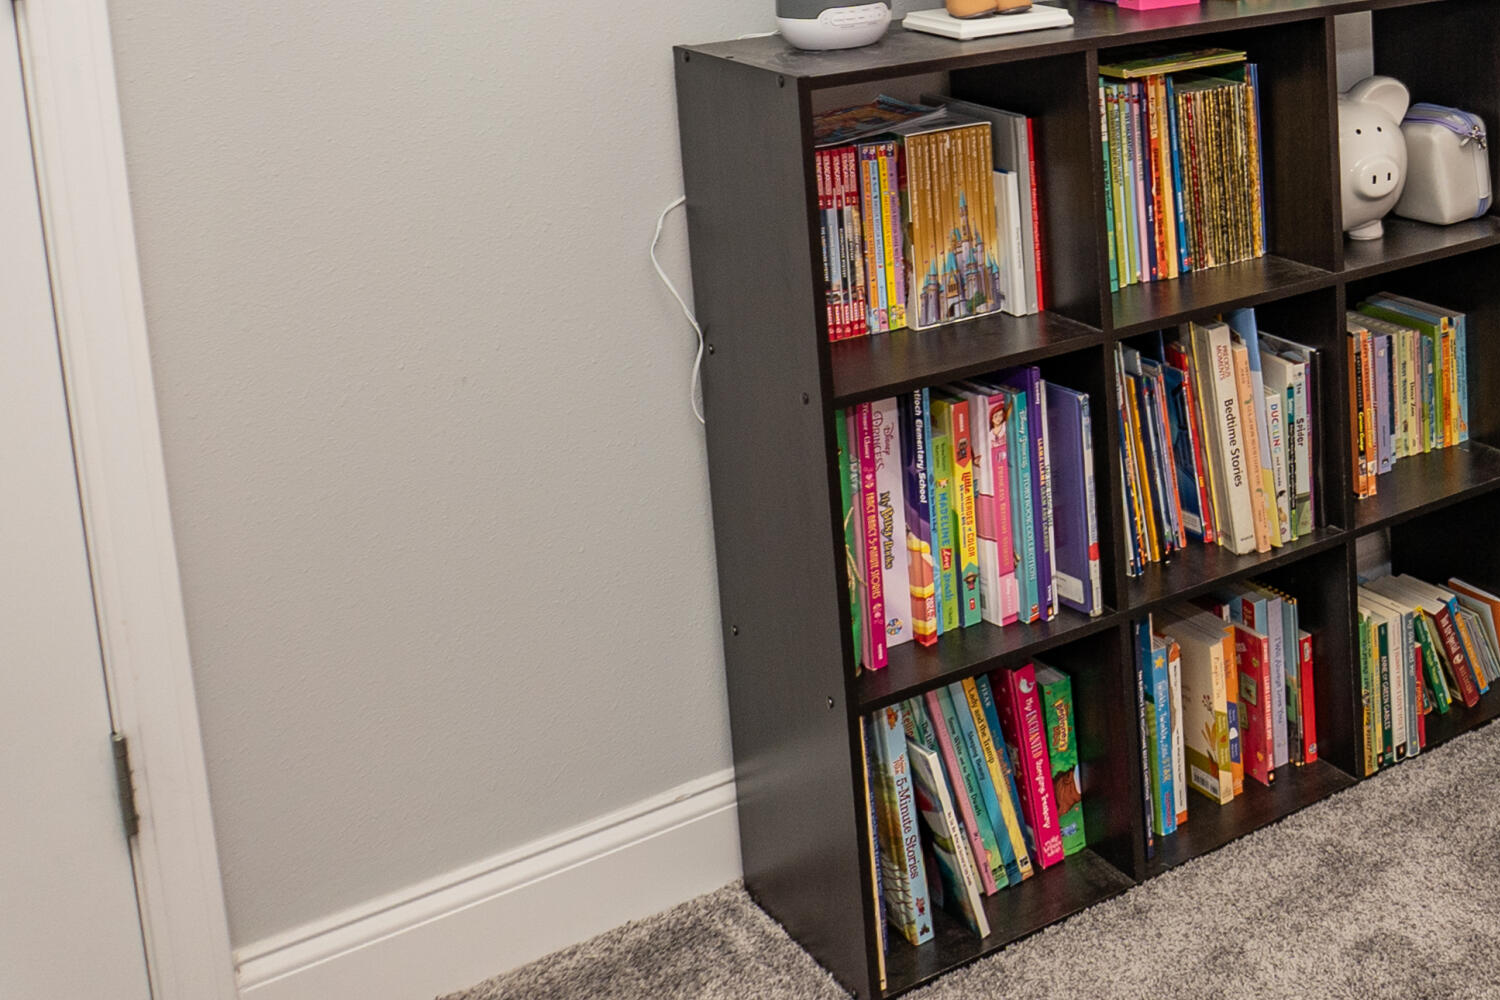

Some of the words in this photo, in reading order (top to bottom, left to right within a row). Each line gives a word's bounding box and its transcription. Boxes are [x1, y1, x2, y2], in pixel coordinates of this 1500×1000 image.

[1216, 345, 1225, 381] MOMENTS
[1221, 345, 1231, 378] PRECIOUS
[1018, 410, 1027, 434] Disney
[1270, 404, 1281, 454] DUCKLING
[1296, 418, 1305, 448] Spider
[872, 411, 886, 472] PRINCESS
[883, 422, 895, 455] Disney
[913, 419, 925, 469] Elementary
[1019, 437, 1029, 468] Princess
[1223, 398, 1237, 446] Bedtime
[1230, 449, 1244, 487] Stories
[880, 491, 890, 507] My
[918, 472, 928, 504] School
[963, 472, 972, 494] Little
[997, 466, 1006, 501] PRINCESS
[1022, 472, 1032, 522] STORYBOOK
[865, 492, 875, 513] FANCY
[963, 495, 974, 526] HEROES
[866, 515, 877, 537] NANCY
[880, 508, 896, 536] Busy
[939, 492, 949, 546] MADELINE
[999, 503, 1008, 535] BEDTIME
[867, 538, 879, 568] 5-MINUTE
[883, 537, 895, 569] Books
[965, 533, 976, 558] COLOR
[1001, 536, 1010, 567] STORIES
[1026, 524, 1036, 580] COLLECTION
[870, 568, 880, 599] STORIES
[1440, 614, 1450, 628] You
[1446, 635, 1460, 654] Special
[1274, 659, 1283, 688] Always
[981, 683, 991, 708] PIXAR
[1023, 697, 1033, 711] My
[967, 688, 979, 708] Lady
[973, 709, 983, 722] and
[978, 724, 988, 737] the
[983, 738, 996, 764] Tramp
[1025, 710, 1043, 759] ENCHANTED
[1056, 702, 1068, 750] Beginner's
[1158, 713, 1169, 743] Twinkle,
[948, 716, 957, 735] Snow
[953, 736, 962, 755] White
[965, 774, 975, 793] Seven
[970, 794, 982, 816] Dwarfs
[967, 731, 980, 759] Sleeping
[976, 759, 986, 780] Beauty
[1161, 757, 1171, 783] STAR
[896, 777, 911, 833] 5-Minute
[905, 835, 919, 879] Stories
